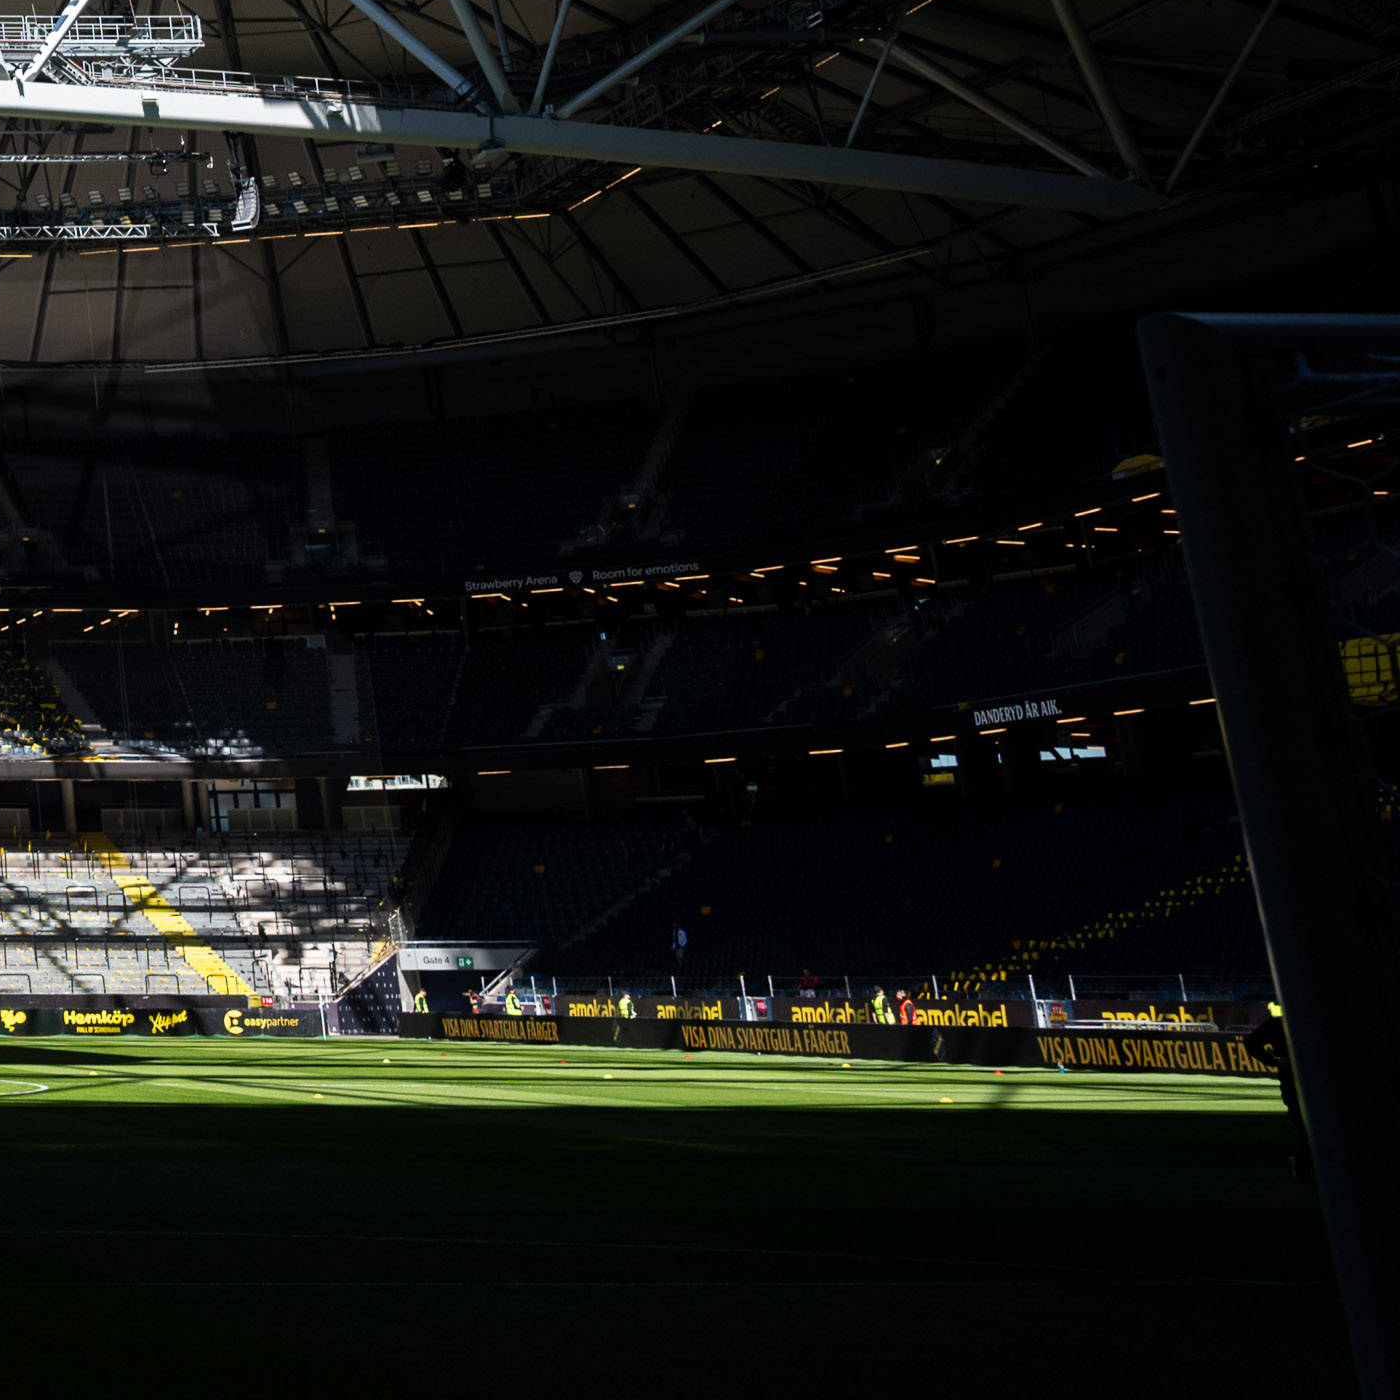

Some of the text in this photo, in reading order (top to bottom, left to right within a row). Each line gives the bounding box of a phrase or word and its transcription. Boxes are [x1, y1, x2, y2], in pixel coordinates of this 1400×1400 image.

[592, 562, 699, 581] Room for emotions
[464, 575, 558, 592] Strawberry Arena
[973, 704, 1024, 726] DANDERYD
[423, 956, 450, 964] Gate 4
[568, 999, 618, 1017] amokab
[656, 1001, 722, 1020] amokabel
[791, 1001, 870, 1024] amokabel
[916, 1003, 1008, 1028] amokabel
[63, 1010, 135, 1028] Hemköp
[244, 1017, 299, 1029] easypartner
[441, 1016, 560, 1042] VISA DINA SVARTGULA FÄRGER
[681, 1024, 851, 1054] VISA DINA SVARTGULA FÄRGER
[1036, 1036, 1075, 1064] VISA
[1076, 1037, 1122, 1067] DINA
[1122, 1038, 1227, 1071] SVARTGULA
